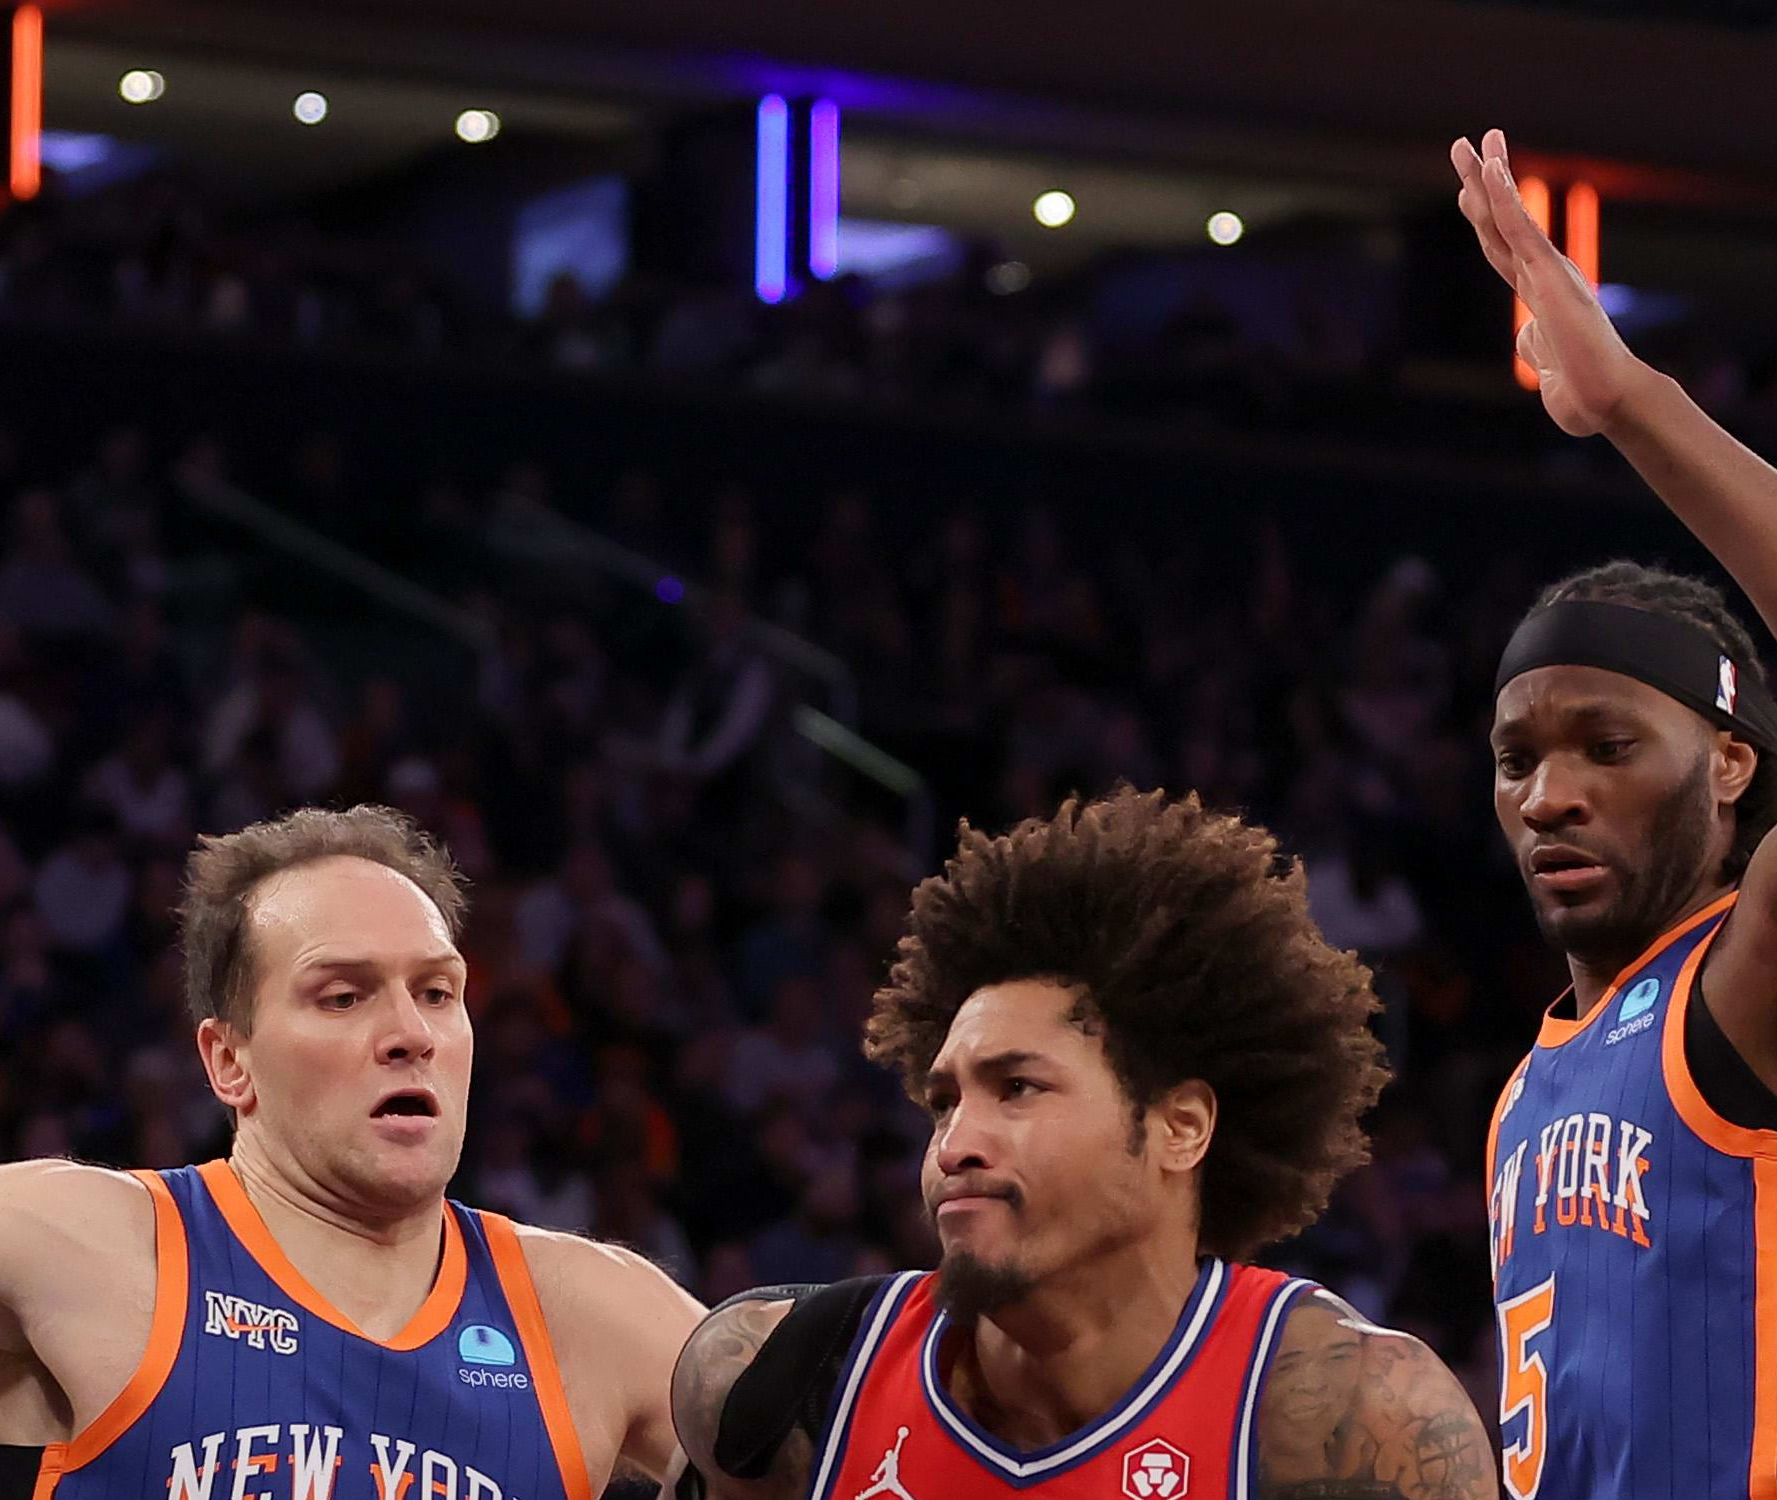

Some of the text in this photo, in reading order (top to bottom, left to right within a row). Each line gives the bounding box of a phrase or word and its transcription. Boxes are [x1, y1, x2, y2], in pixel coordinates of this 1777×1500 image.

[1533, 1112, 1655, 1248] YORK
[204, 1289, 299, 1355] NYC
[458, 1366, 529, 1390] sphere
